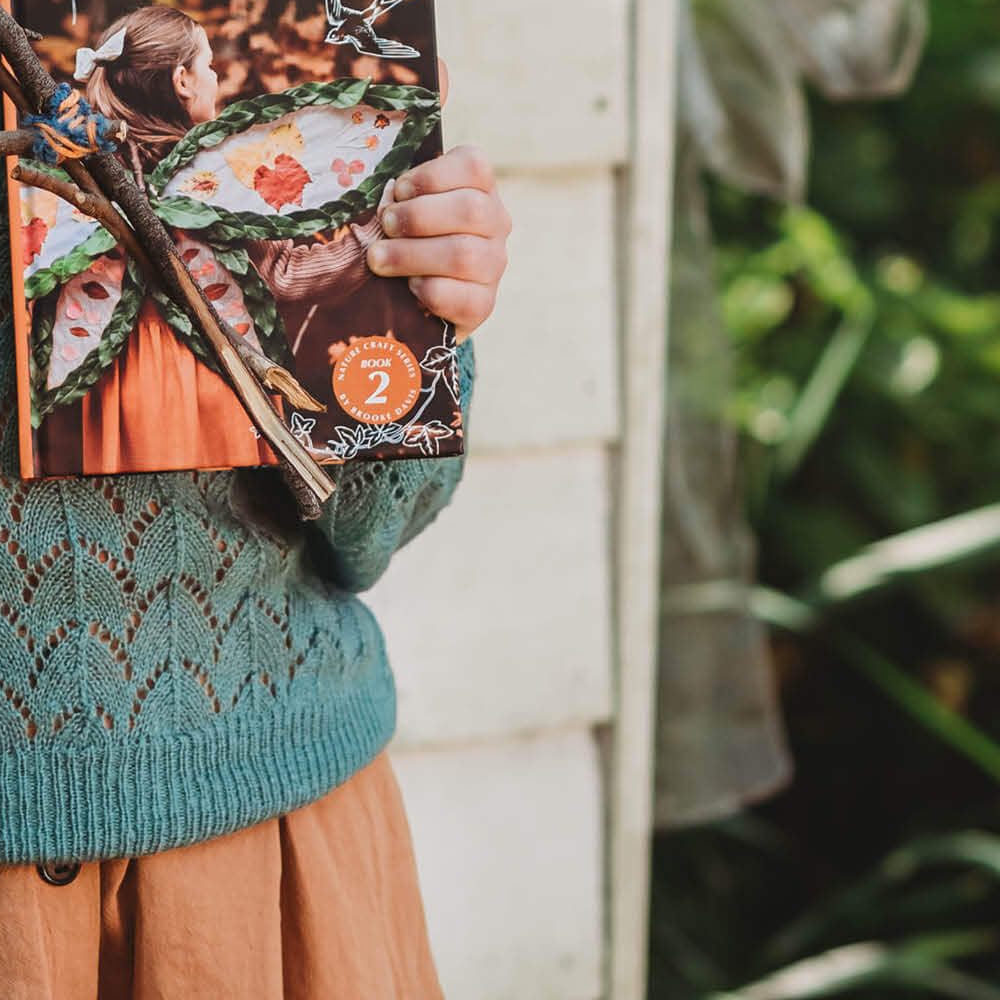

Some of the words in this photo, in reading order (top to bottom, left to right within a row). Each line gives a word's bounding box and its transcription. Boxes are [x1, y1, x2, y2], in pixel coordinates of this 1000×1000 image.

[337, 347, 361, 381] NATURE
[363, 341, 395, 351] CRAFT
[360, 358, 392, 369] BOOK
[364, 371, 391, 405] 2
